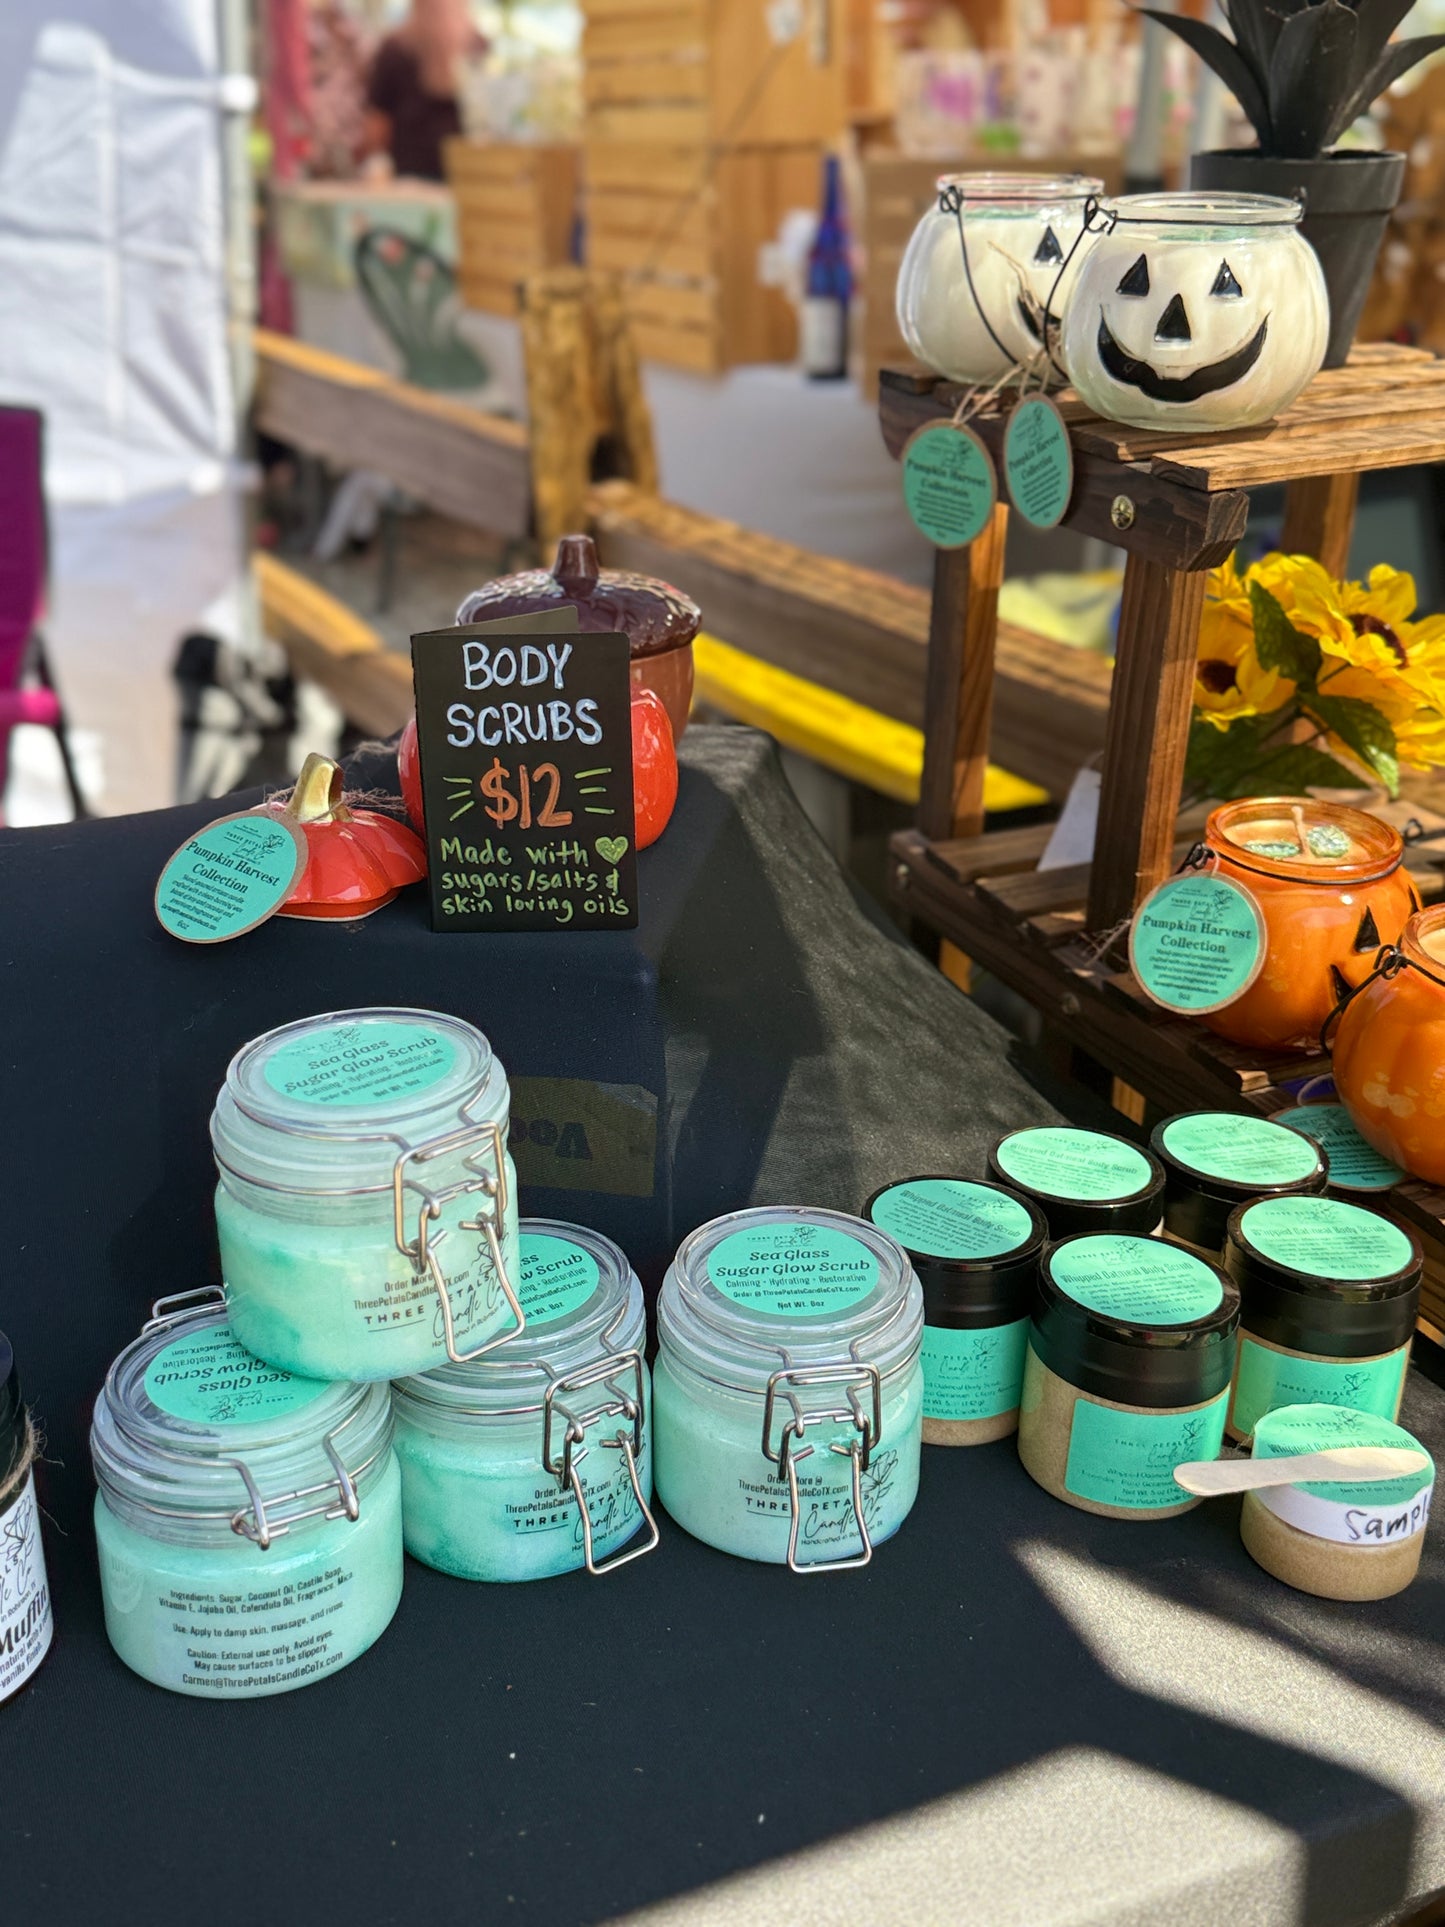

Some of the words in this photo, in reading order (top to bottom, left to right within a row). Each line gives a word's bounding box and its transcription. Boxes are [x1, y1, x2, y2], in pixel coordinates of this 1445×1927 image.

[462, 641, 573, 690] BODY
[447, 698, 602, 747] SCRUBS
[479, 757, 573, 830] $12
[440, 836, 512, 866] Made
[525, 839, 590, 868] with
[186, 841, 234, 868] Pumpkin
[234, 859, 281, 887] Harvest
[192, 862, 249, 893] Collection
[441, 869, 599, 898] sugars/salts
[441, 894, 494, 915] skin
[505, 894, 574, 923] loving
[583, 895, 630, 915] oils
[1142, 915, 1197, 934] Pumpkin
[1199, 922, 1252, 940] Harvest
[1160, 934, 1227, 954] Collection
[284, 1068, 339, 1094] Sugar
[341, 1053, 385, 1074] Glow
[387, 1036, 438, 1059] Scrub
[308, 1054, 342, 1071] Sea
[341, 1039, 390, 1060] Glass
[303, 1080, 344, 1098] Calming
[535, 1253, 583, 1276] Scrub
[750, 1251, 780, 1261] Sea
[784, 1249, 830, 1262] Glass
[541, 1266, 588, 1287] Restorative
[716, 1266, 770, 1278] Sugar
[772, 1263, 816, 1276] Glow
[819, 1260, 870, 1273] Scrub
[384, 1279, 410, 1293] Order
[726, 1278, 761, 1288] Calming
[769, 1276, 811, 1287] Hydrating
[819, 1273, 867, 1283] Restorative
[733, 1290, 752, 1298] Order
[364, 1305, 426, 1326] THREE
[162, 1355, 217, 1370] Restorative
[217, 1358, 267, 1375] Glow
[154, 1367, 214, 1386] Scrub
[197, 1376, 253, 1393] Glass
[256, 1371, 292, 1386] Sea
[534, 1486, 556, 1499] Order
[745, 1497, 788, 1511] THRE
[811, 1494, 870, 1511] PETAS
[514, 1511, 569, 1528] THREE
[589, 1483, 628, 1511] ETALS
[805, 1505, 857, 1538] Candle
[248, 1588, 281, 1602] Coconut
[297, 1575, 324, 1591] Castile
[159, 1597, 187, 1611] Vitamin
[198, 1604, 225, 1616] Jojoba
[241, 1600, 282, 1613] Calendula
[0, 1583, 47, 1657] Muffin
[190, 1625, 212, 1638] Apply
[213, 1629, 222, 1638] to
[224, 1628, 248, 1638] damp
[310, 1609, 325, 1622] and
[221, 1650, 254, 1660] External
[256, 1649, 271, 1657] use
[294, 1635, 315, 1650] Avoid
[194, 1660, 211, 1671] May
[213, 1663, 237, 1671] cause
[238, 1660, 274, 1671] surfaces
[276, 1657, 285, 1666] to
[286, 1655, 297, 1664] be
